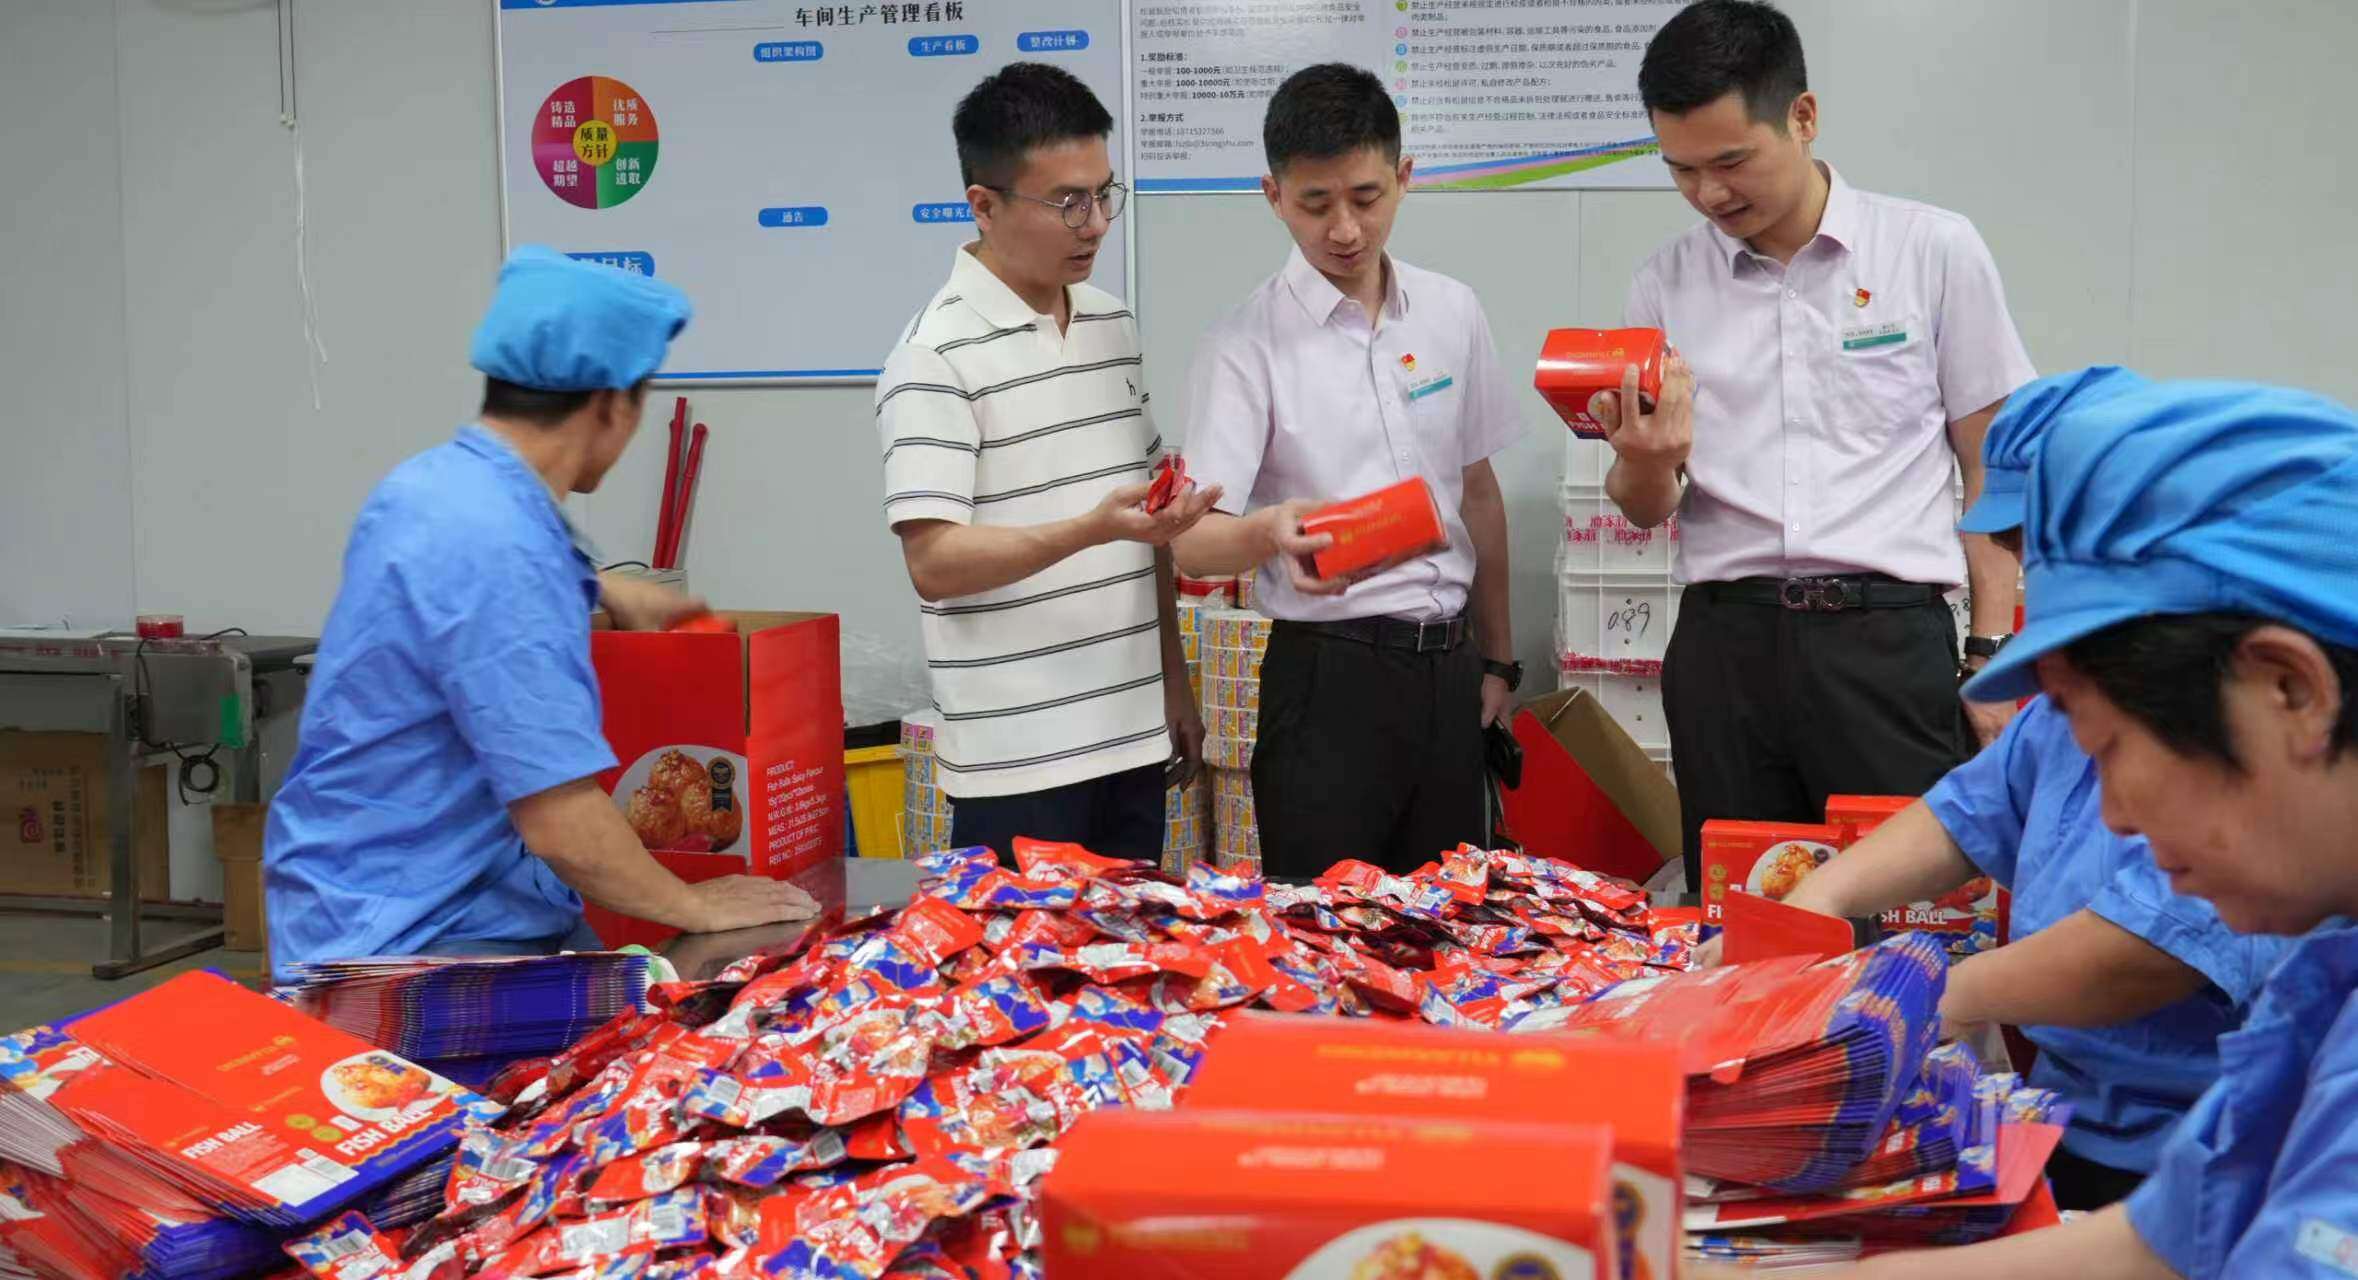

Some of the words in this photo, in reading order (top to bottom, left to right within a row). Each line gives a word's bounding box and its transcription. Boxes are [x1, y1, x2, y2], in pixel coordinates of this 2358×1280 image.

[794, 2, 964, 28] 车间生产管理看板
[761, 45, 816, 58] 组织架构图
[921, 39, 966, 53] 生产看板
[613, 98, 638, 111] 优质
[552, 115, 576, 128] 精品
[613, 113, 638, 127] 服务
[581, 127, 608, 140] 质量
[582, 144, 608, 158] 方针
[553, 160, 578, 173] 超越
[616, 158, 639, 171] 创新
[553, 174, 578, 187] 期望
[1707, 904, 1723, 918] FI
[1905, 911, 1948, 925] BALL
[335, 1128, 388, 1156] FISH
[379, 1106, 434, 1133] BALL
[181, 1137, 224, 1159] FISH
[216, 1121, 263, 1142] BALL
